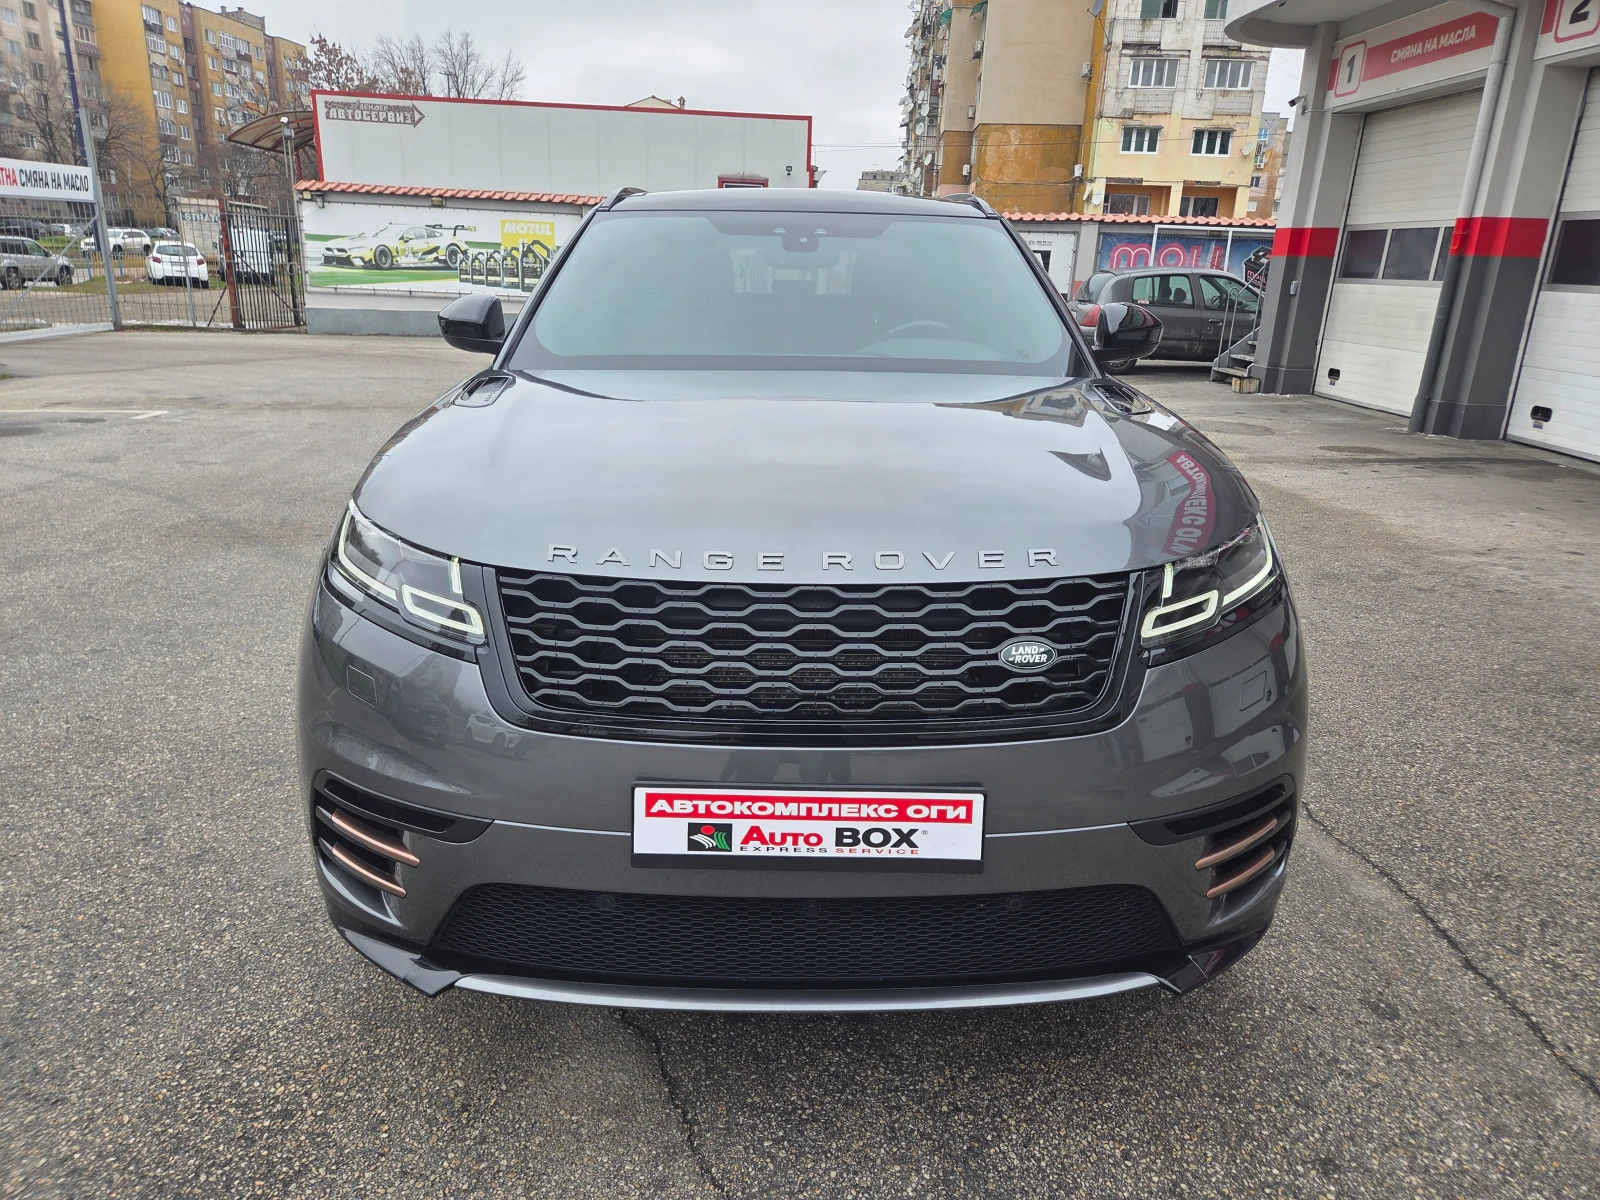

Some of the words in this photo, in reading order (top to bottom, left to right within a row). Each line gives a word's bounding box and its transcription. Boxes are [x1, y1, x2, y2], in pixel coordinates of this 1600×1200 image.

[1568, 0, 1592, 25] 2
[1346, 54, 1357, 84] 1
[1390, 44, 1423, 64] СМЯНА
[1423, 39, 1439, 53] НА
[1438, 24, 1476, 51] МАСЛА
[329, 108, 413, 124] АВТОСЕРВИЗ
[0, 167, 18, 186] ТНА
[19, 169, 50, 190] СМЯНА
[50, 171, 62, 190] НА
[63, 173, 89, 192] МАСЛО
[503, 221, 552, 236] MOTUL
[547, 543, 784, 571] RANGE
[822, 548, 1059, 570] ROVER
[1011, 645, 1039, 655] LAND
[1014, 653, 1048, 664] ROVER
[649, 798, 900, 819] АВТОКОМПЛЕКС
[906, 803, 968, 820] ОГИ
[739, 845, 828, 853] EXPRESS
